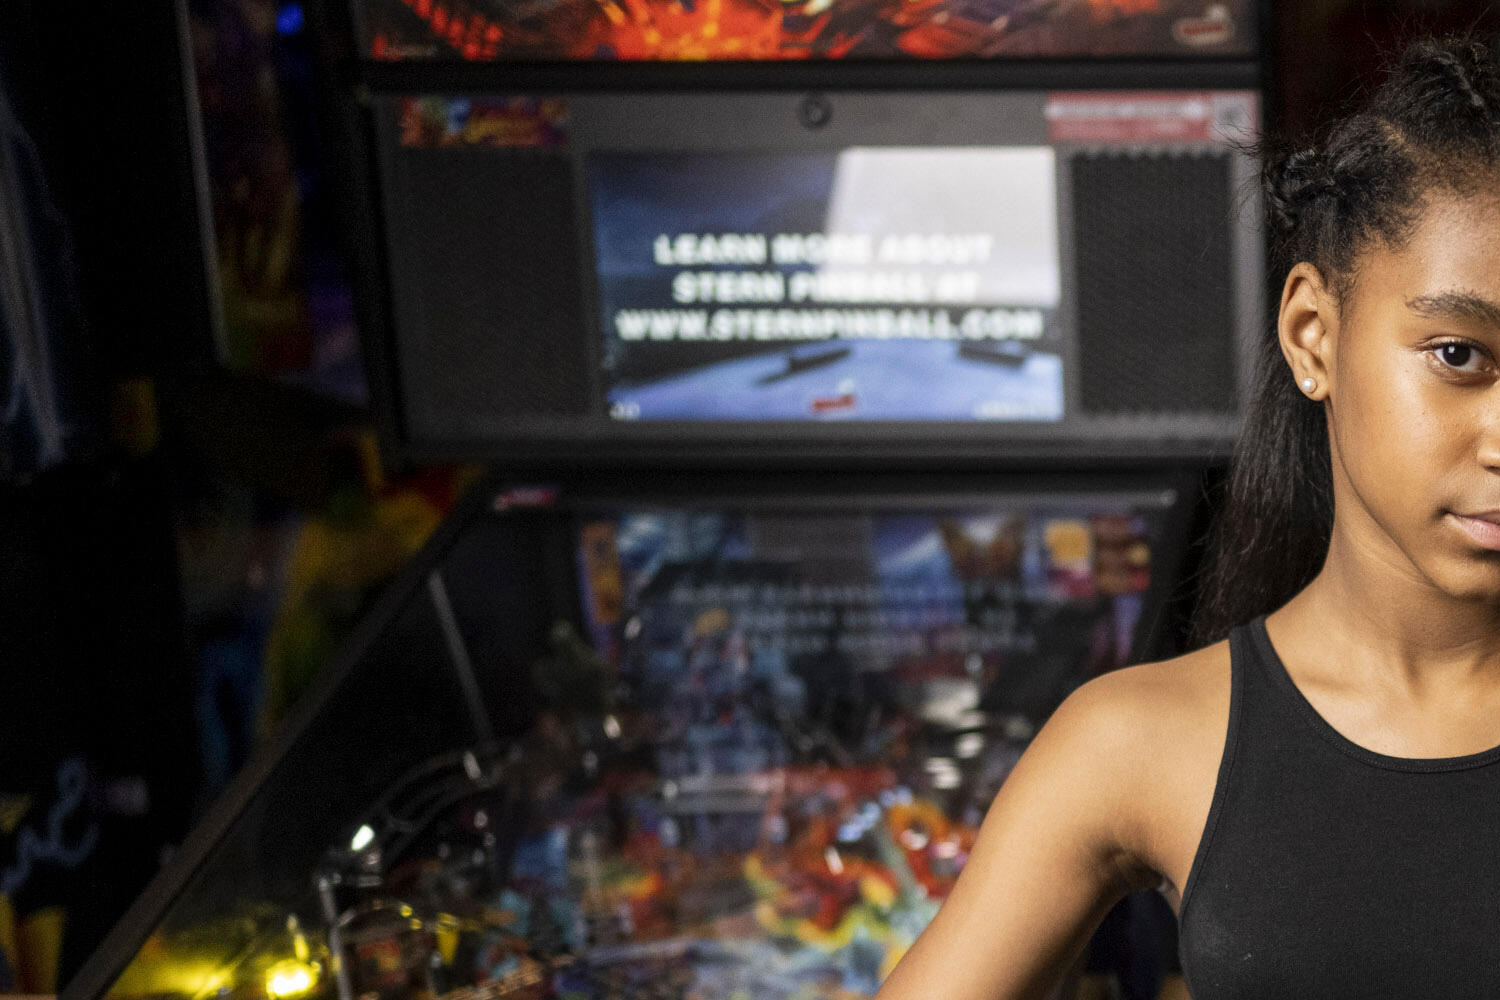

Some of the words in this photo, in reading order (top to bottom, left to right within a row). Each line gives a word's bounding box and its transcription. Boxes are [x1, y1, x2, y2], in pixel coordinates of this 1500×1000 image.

[653, 233, 767, 265] LEARN
[772, 233, 873, 265] MORE
[879, 233, 993, 264] ABOUT
[672, 271, 784, 303] STERN
[615, 309, 1043, 340] WWW.STERNPINBALL.COM
